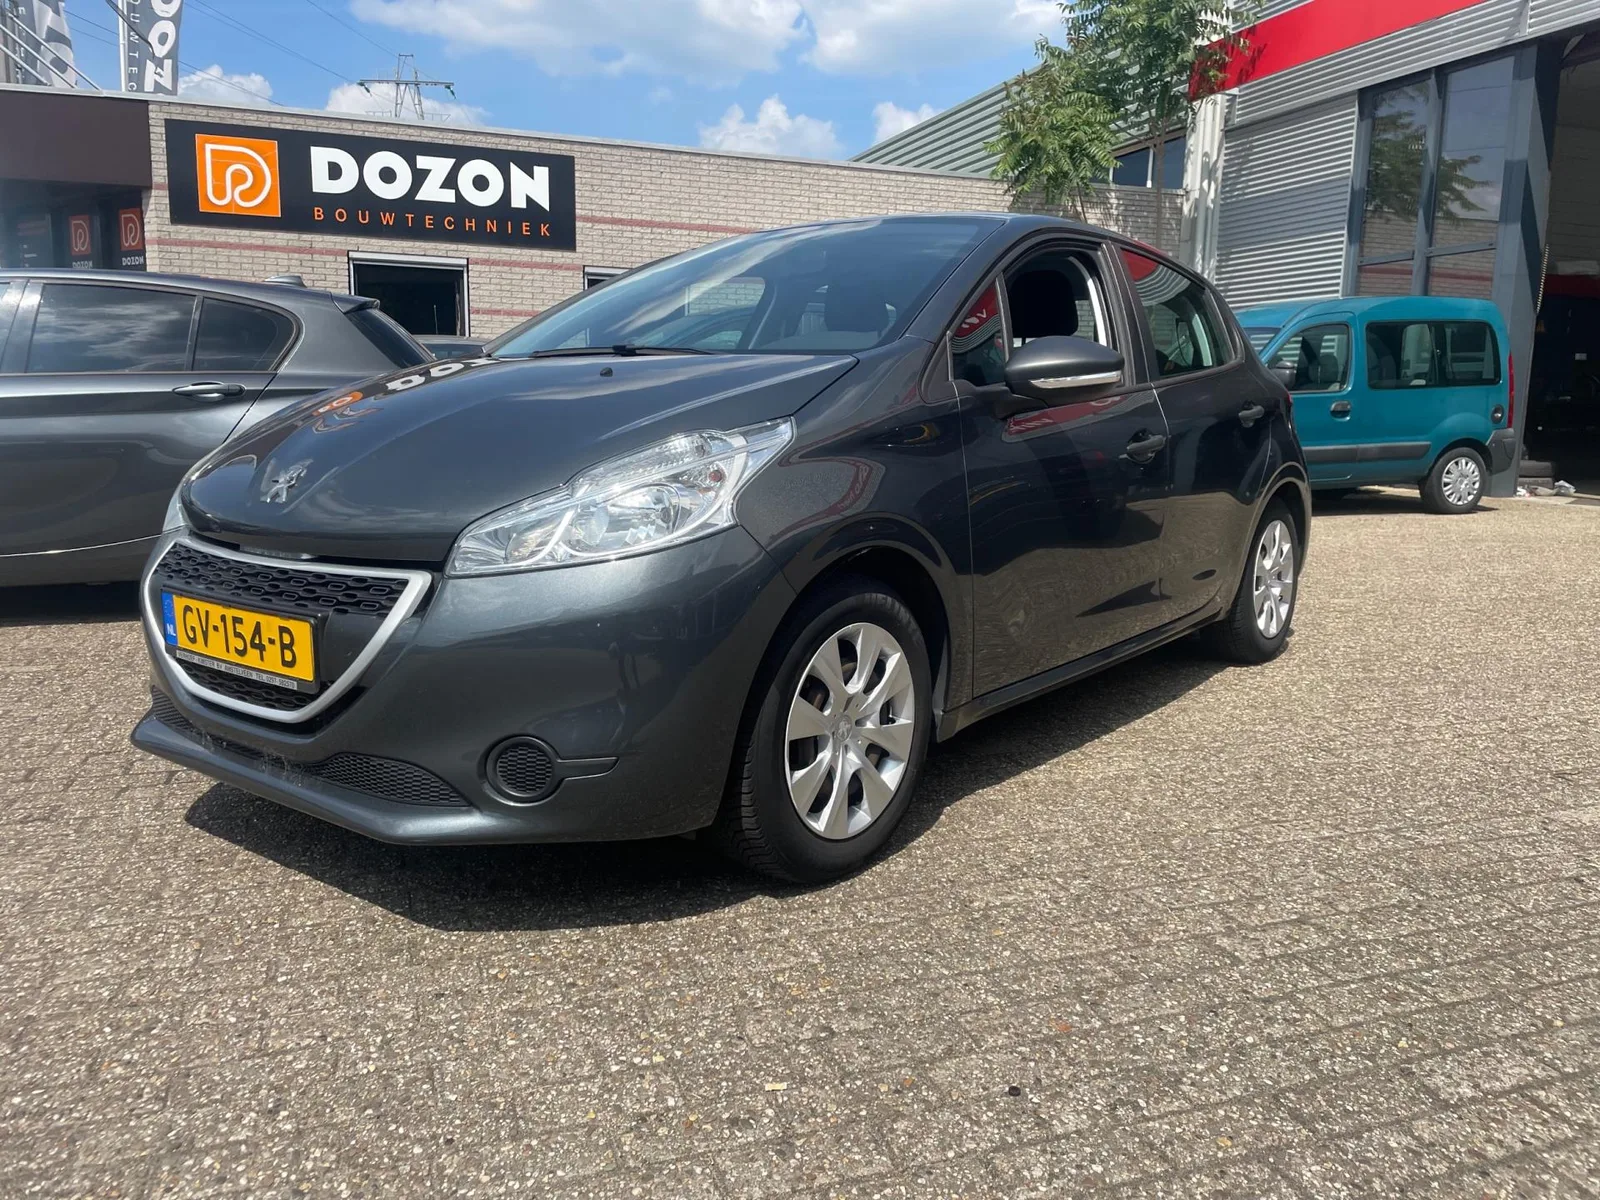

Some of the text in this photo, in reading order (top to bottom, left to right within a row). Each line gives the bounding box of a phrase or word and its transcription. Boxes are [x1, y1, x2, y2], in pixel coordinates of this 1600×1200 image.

[310, 145, 550, 212] DOZON
[314, 206, 551, 237] BOUWTECHNIEK
[122, 256, 144, 266] DOZON
[167, 623, 177, 637] NL
[182, 604, 297, 669] GV-154-B
